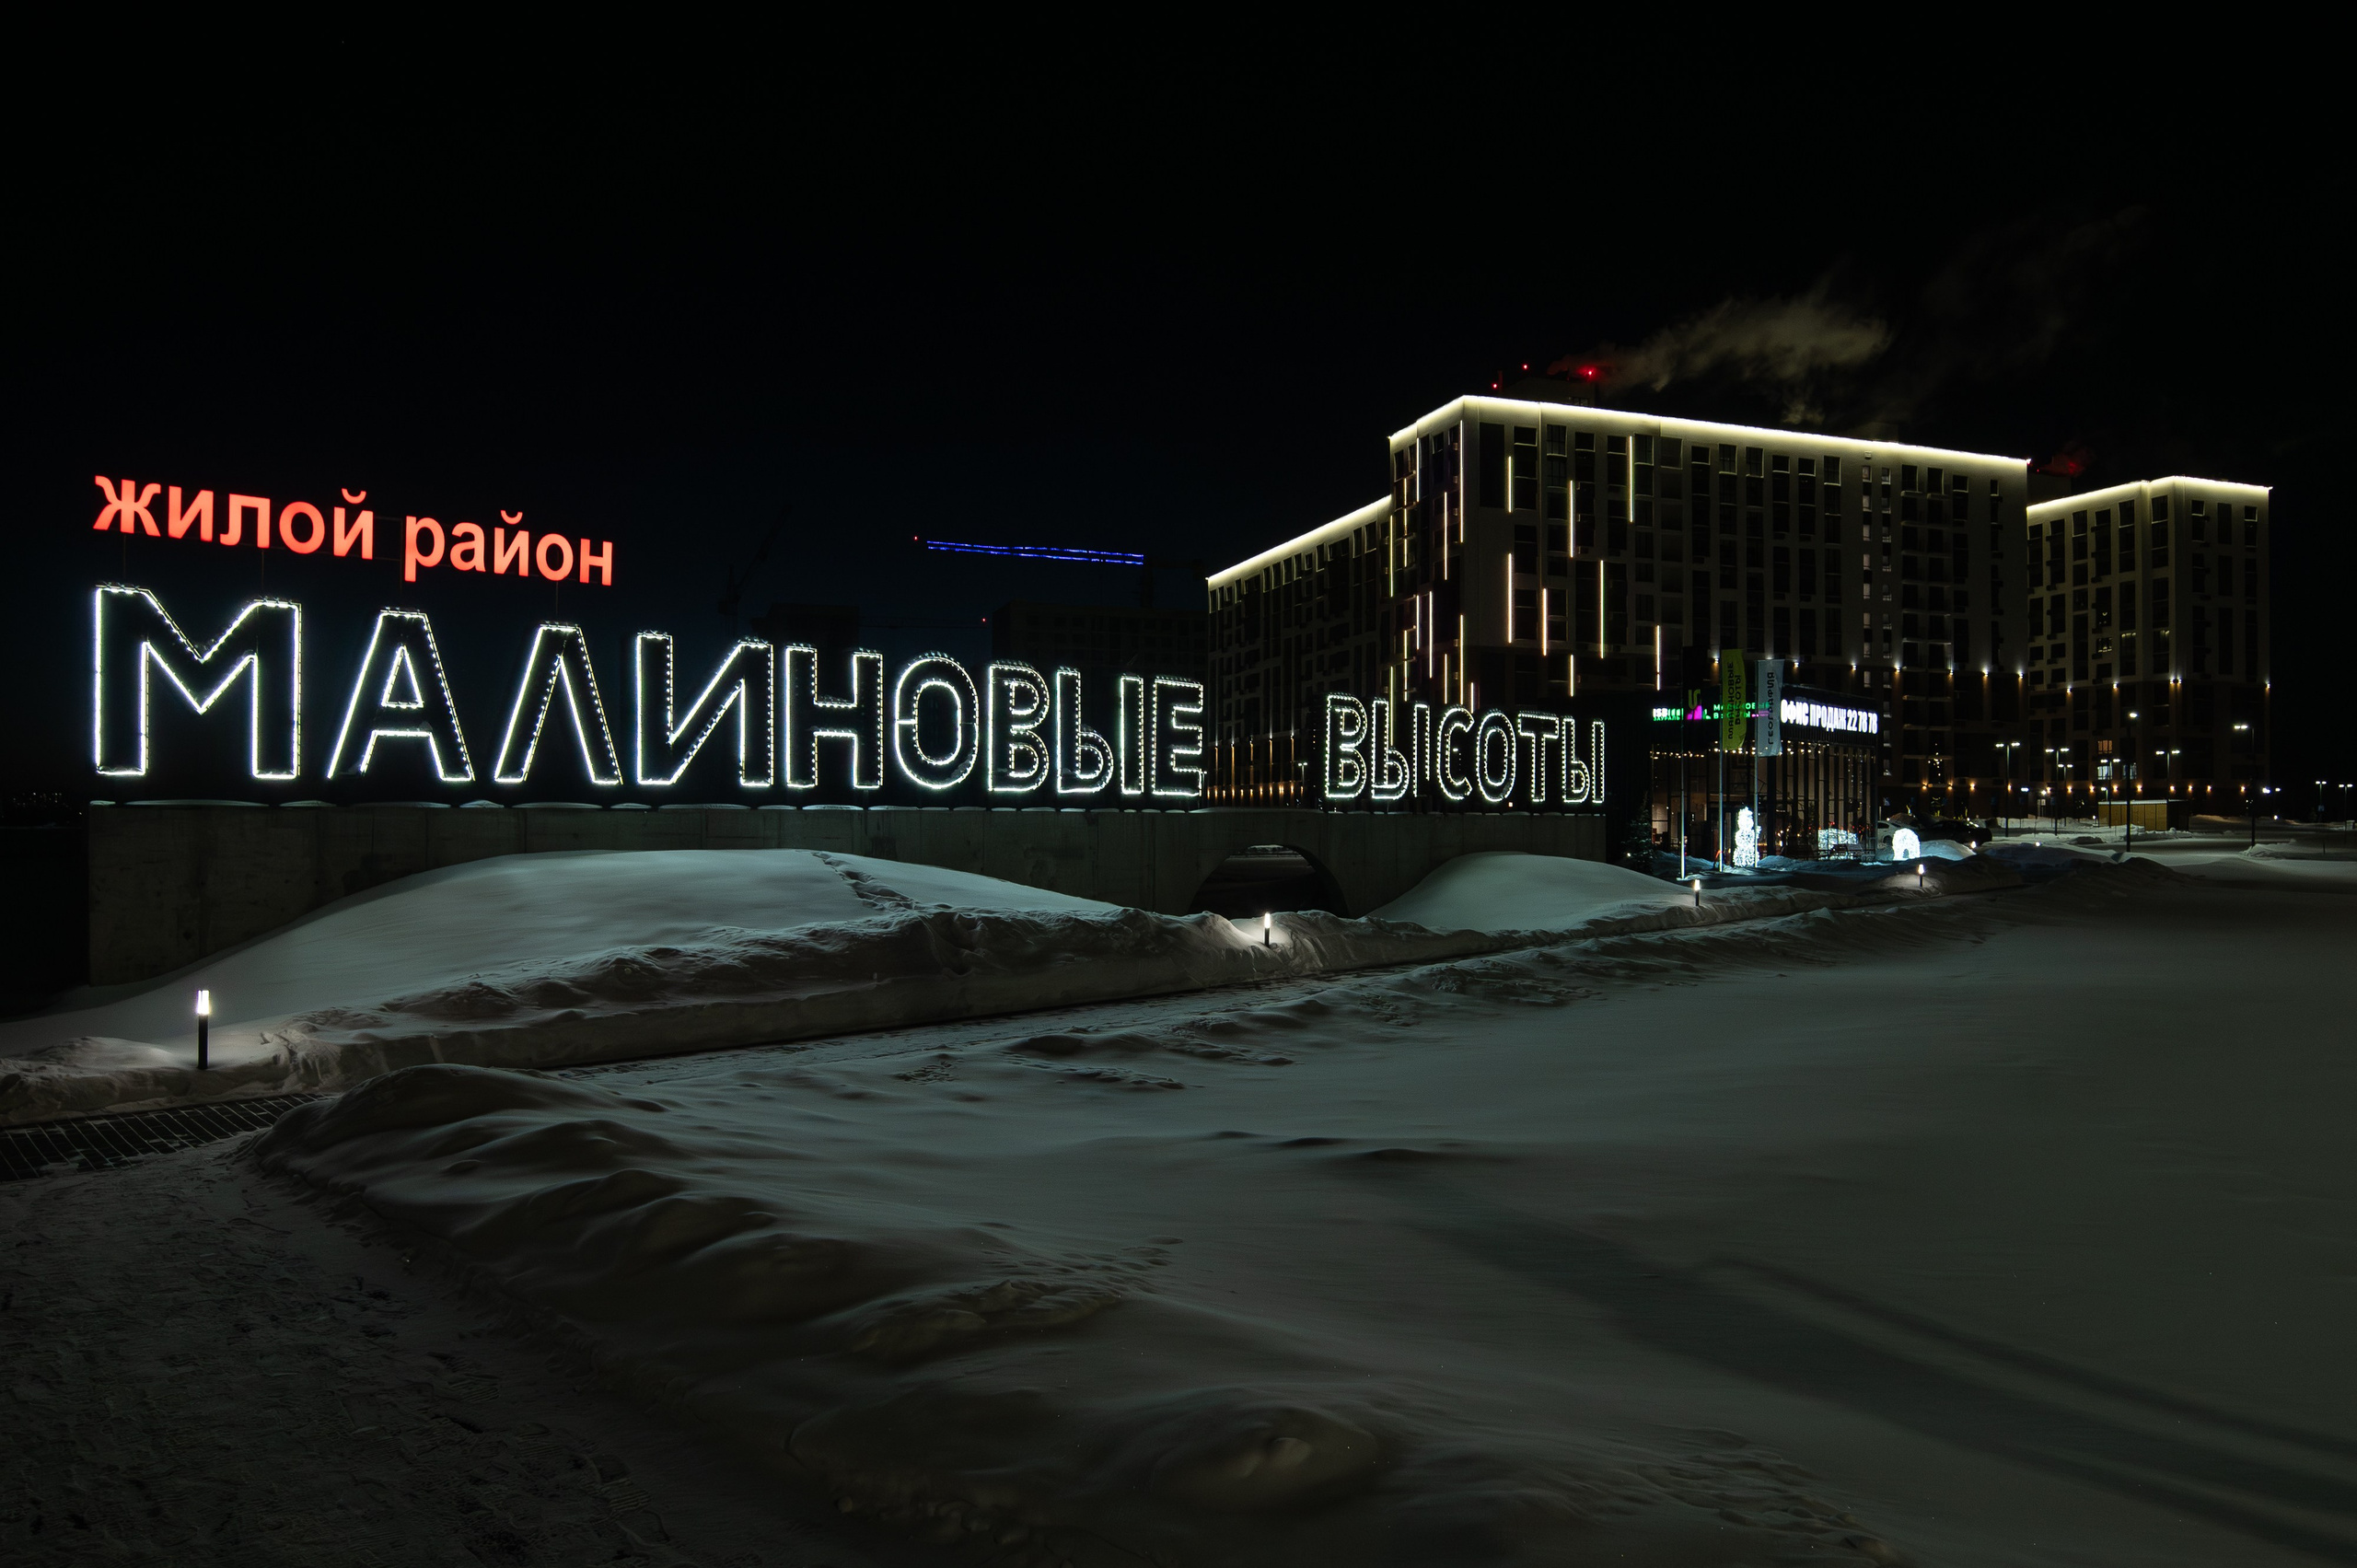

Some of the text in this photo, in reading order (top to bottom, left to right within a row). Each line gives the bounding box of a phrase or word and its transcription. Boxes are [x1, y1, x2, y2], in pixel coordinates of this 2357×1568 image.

[93, 475, 613, 587] жилой район
[95, 583, 1606, 804] МАЛИНОВЫЕ ВЫСОТЫ
[1781, 699, 1878, 735] ОФИС ПРОДАЖ 22 78 78
